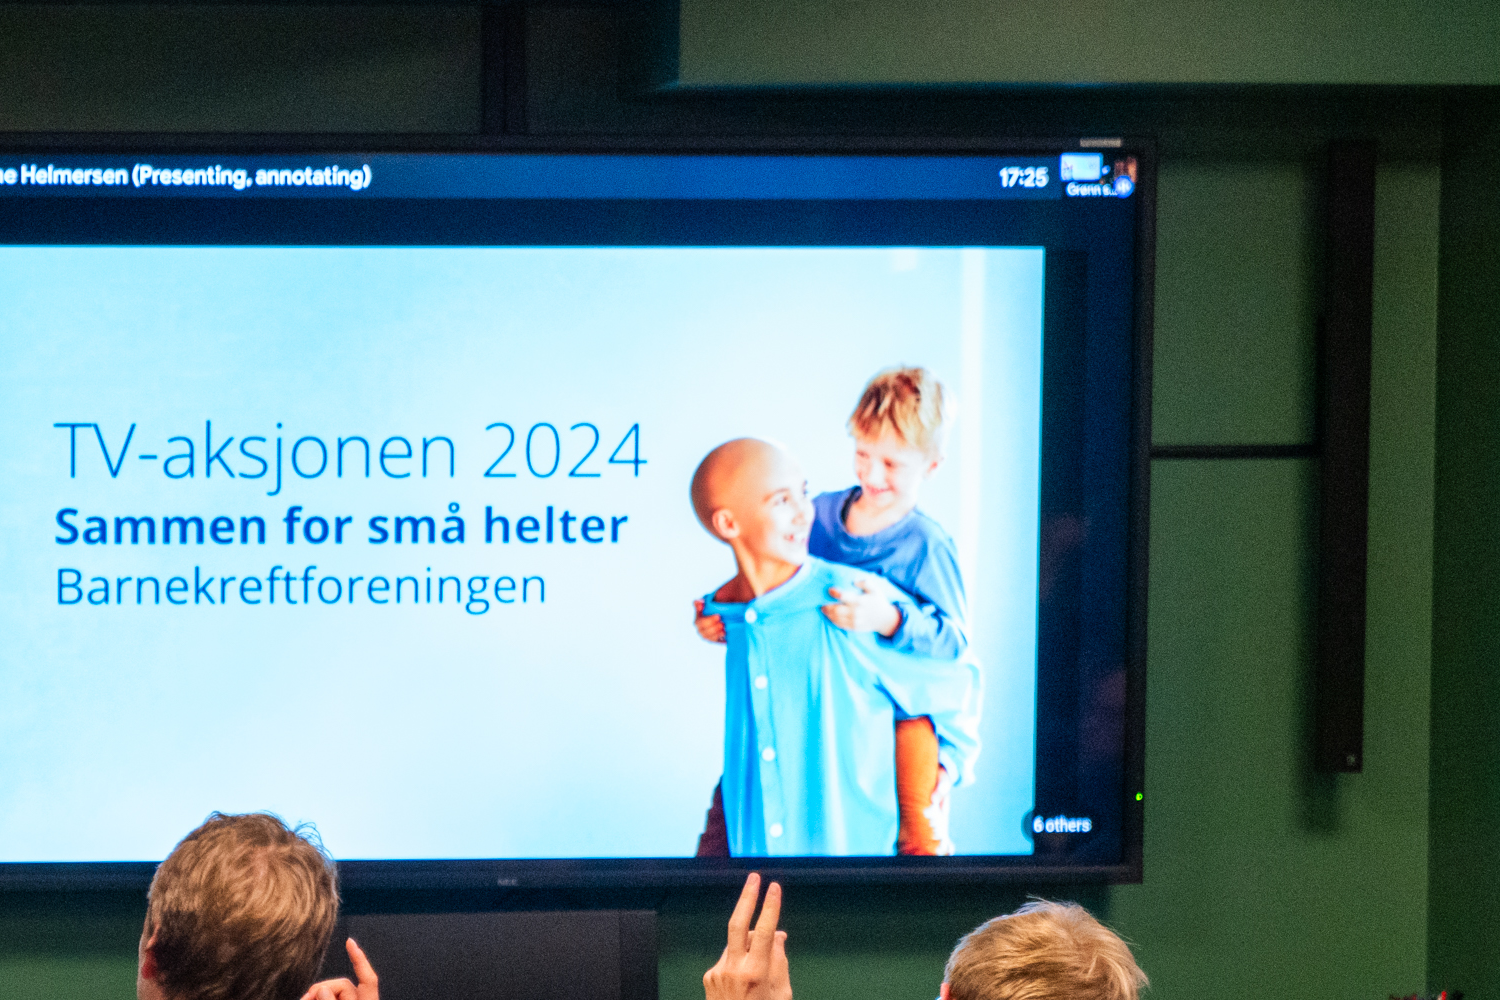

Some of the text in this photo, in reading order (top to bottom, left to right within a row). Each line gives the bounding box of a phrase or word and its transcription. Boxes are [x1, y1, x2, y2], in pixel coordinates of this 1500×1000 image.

[20, 164, 129, 186] Helmersen
[131, 163, 253, 190] (Presenting,
[255, 164, 372, 191] annotating)
[999, 166, 1049, 188] 17:25
[53, 419, 648, 496] TV-aksjonen 2024
[54, 502, 629, 546] Sammen for små helter
[56, 564, 546, 616] Barnekreftforeningen
[1032, 814, 1092, 833] 6 others
